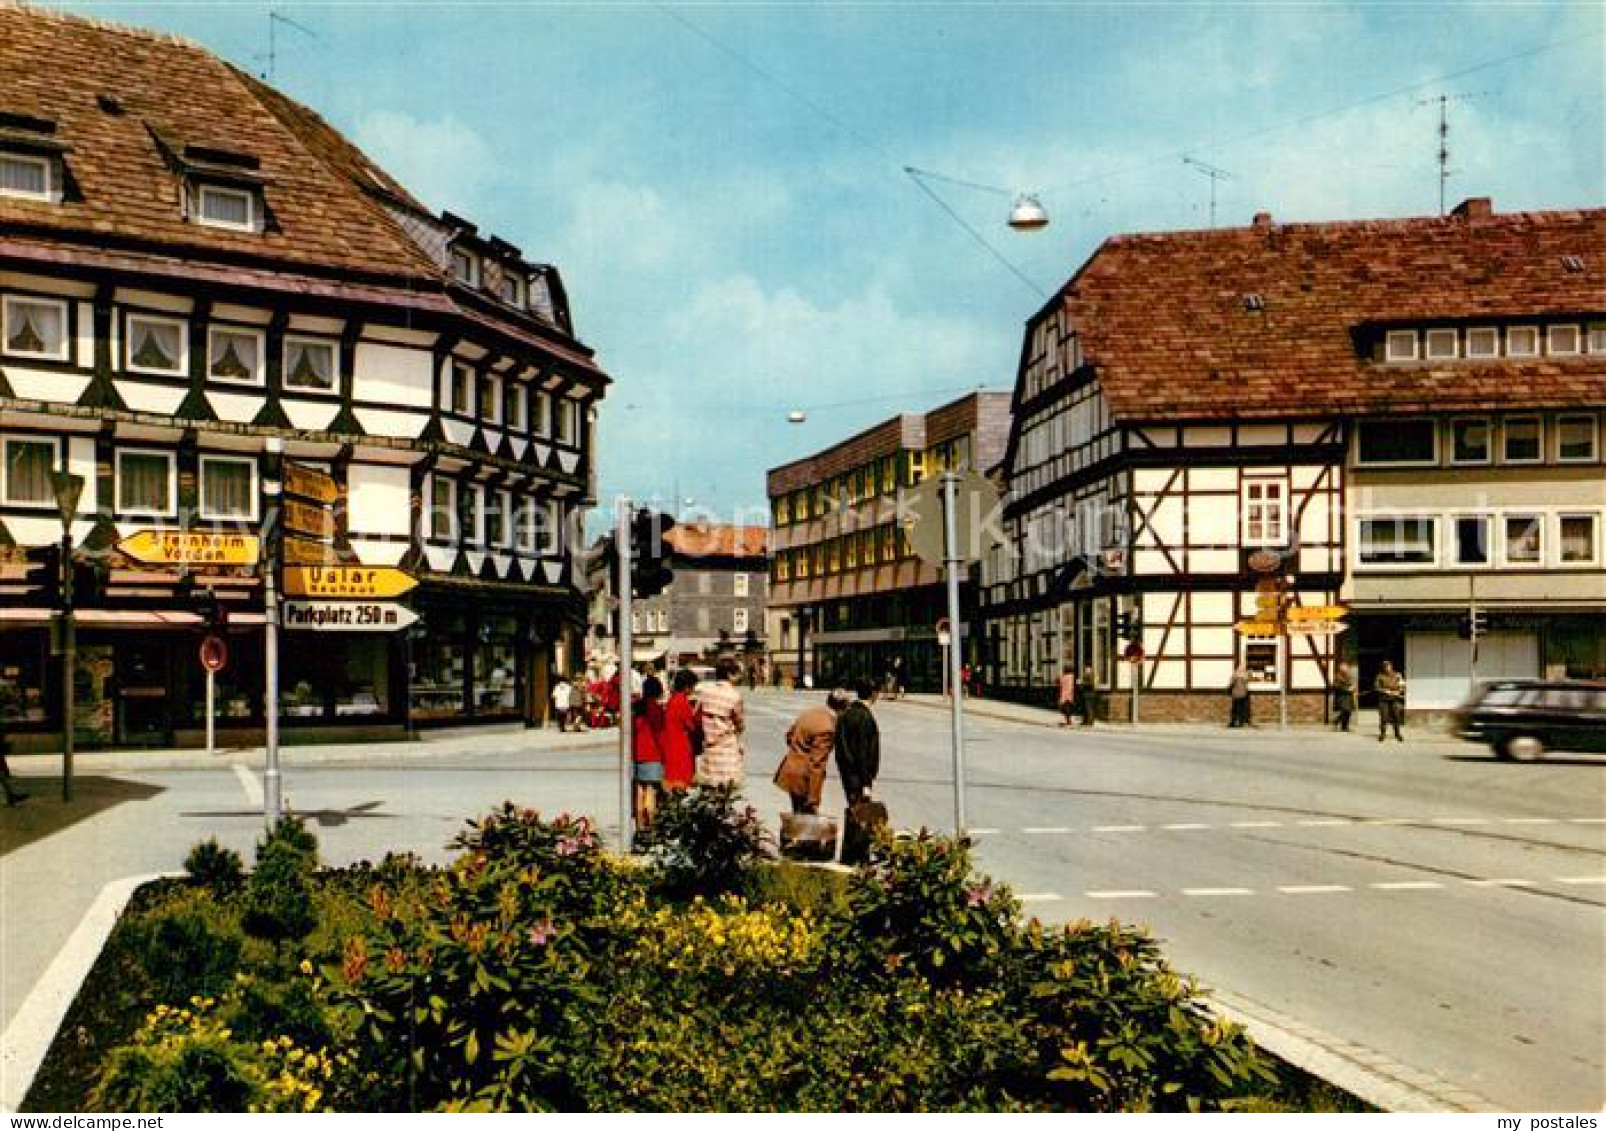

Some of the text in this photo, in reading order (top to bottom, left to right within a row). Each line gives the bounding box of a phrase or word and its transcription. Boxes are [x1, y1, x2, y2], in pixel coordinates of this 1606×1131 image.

[309, 566, 376, 584] Uslar
[287, 604, 399, 627] Parkplatz 250 m
